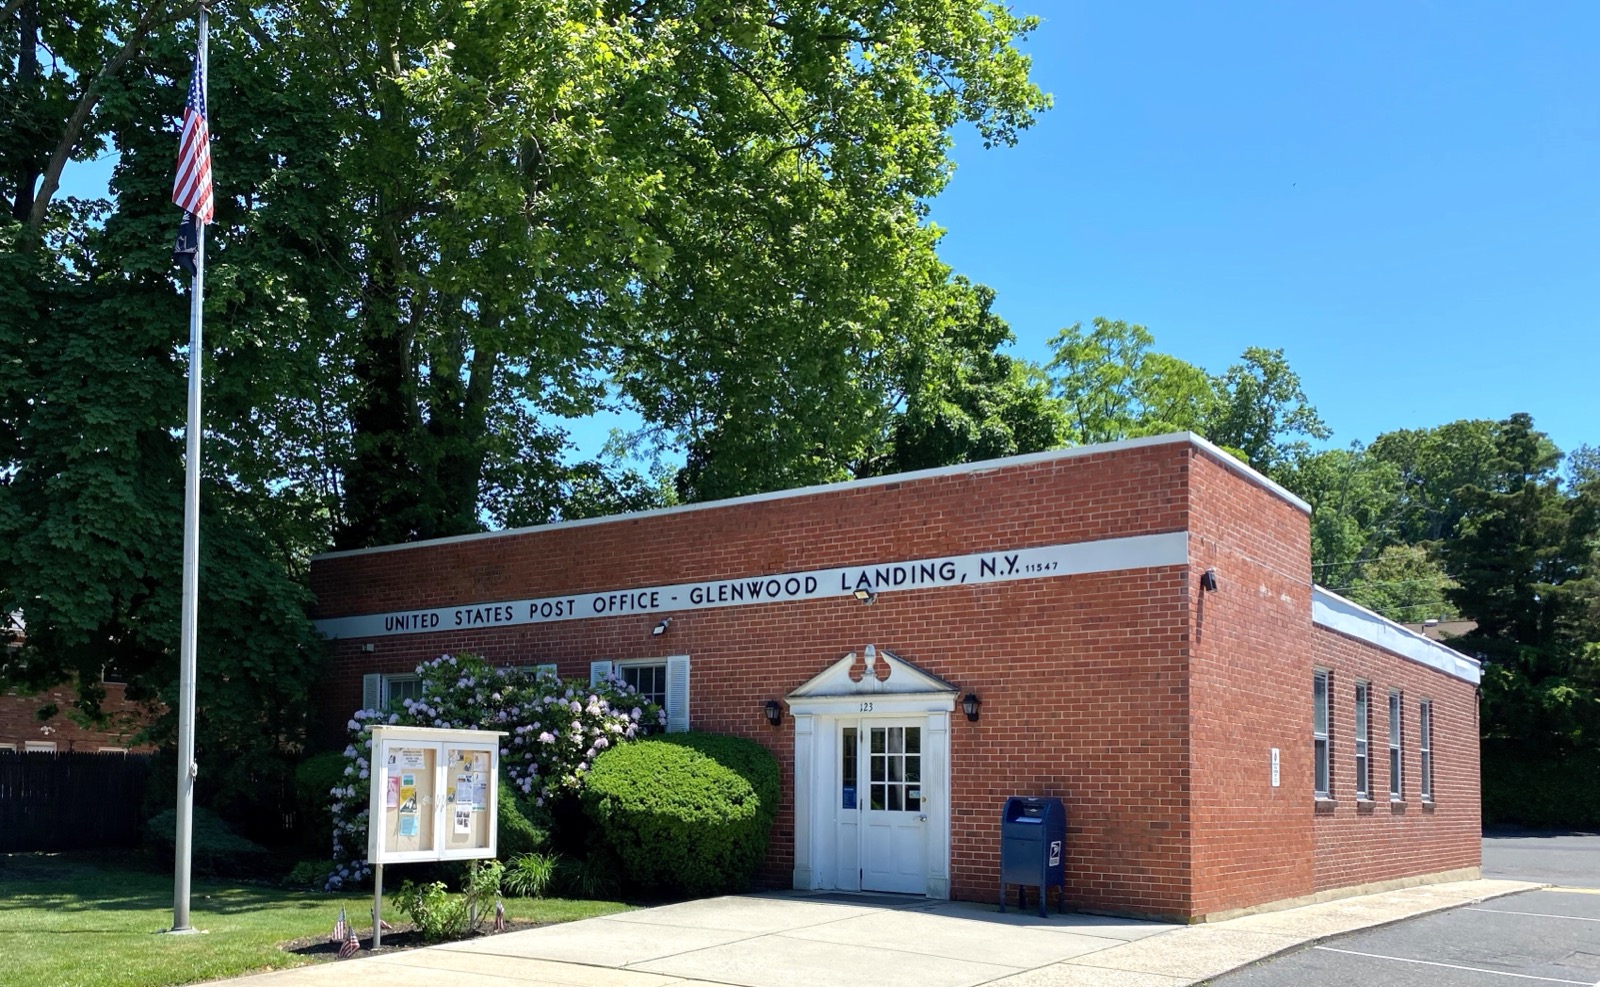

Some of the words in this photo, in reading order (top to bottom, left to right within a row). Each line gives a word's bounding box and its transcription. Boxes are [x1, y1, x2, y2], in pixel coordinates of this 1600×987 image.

[385, 613, 440, 631] UNITED
[455, 605, 513, 626] STATES
[529, 600, 576, 619] POST
[593, 591, 660, 613] OFFICE
[690, 576, 818, 604] GLENWOOD
[841, 561, 967, 590] LANDING,
[980, 554, 1020, 577] N.Y.
[1025, 562, 1058, 573] 11547
[860, 702, 873, 712] 123
